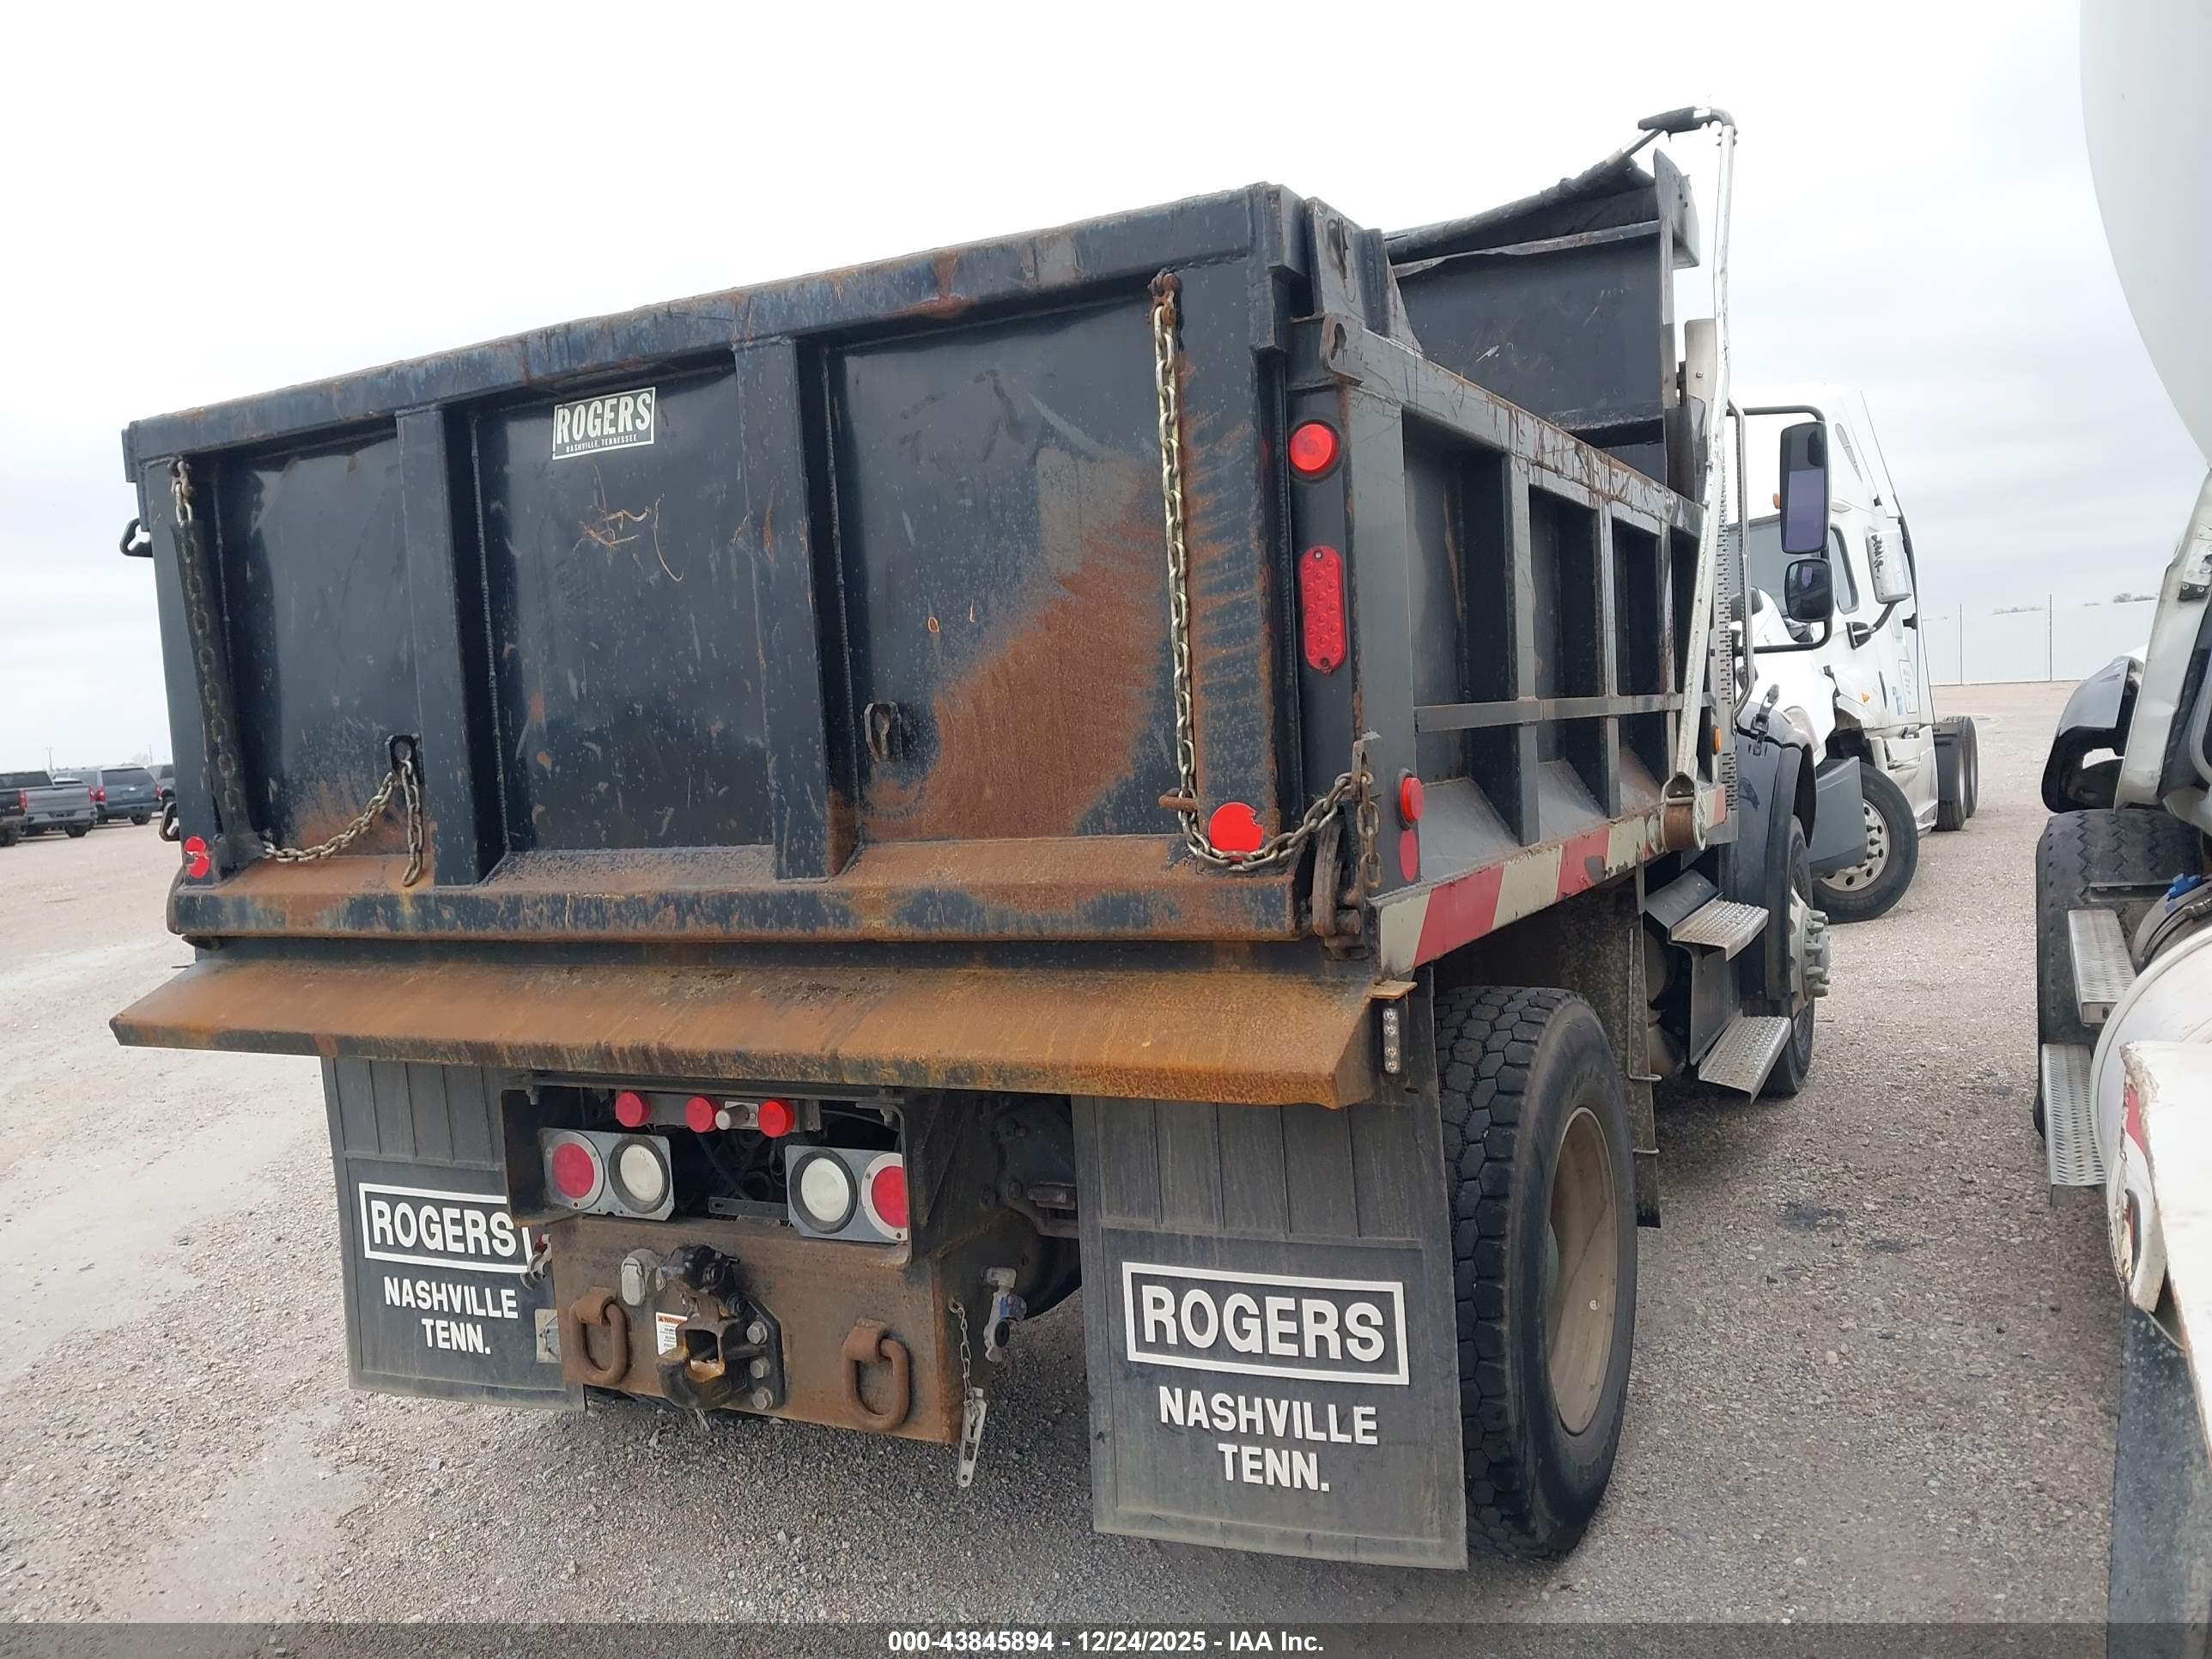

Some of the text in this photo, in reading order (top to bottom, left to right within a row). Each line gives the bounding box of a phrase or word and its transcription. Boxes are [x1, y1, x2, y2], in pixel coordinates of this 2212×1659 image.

[556, 392, 651, 444] ROGERS
[601, 434, 637, 446] TENNESSEE
[370, 1200, 516, 1256] ROGERS
[384, 1276, 519, 1319] NASHVILLE
[421, 1318, 491, 1355] TENN.
[1141, 1285, 1385, 1362] ROGERS
[1159, 1385, 1378, 1445] NASHVILLE
[1218, 1443, 1330, 1492] TENN.
